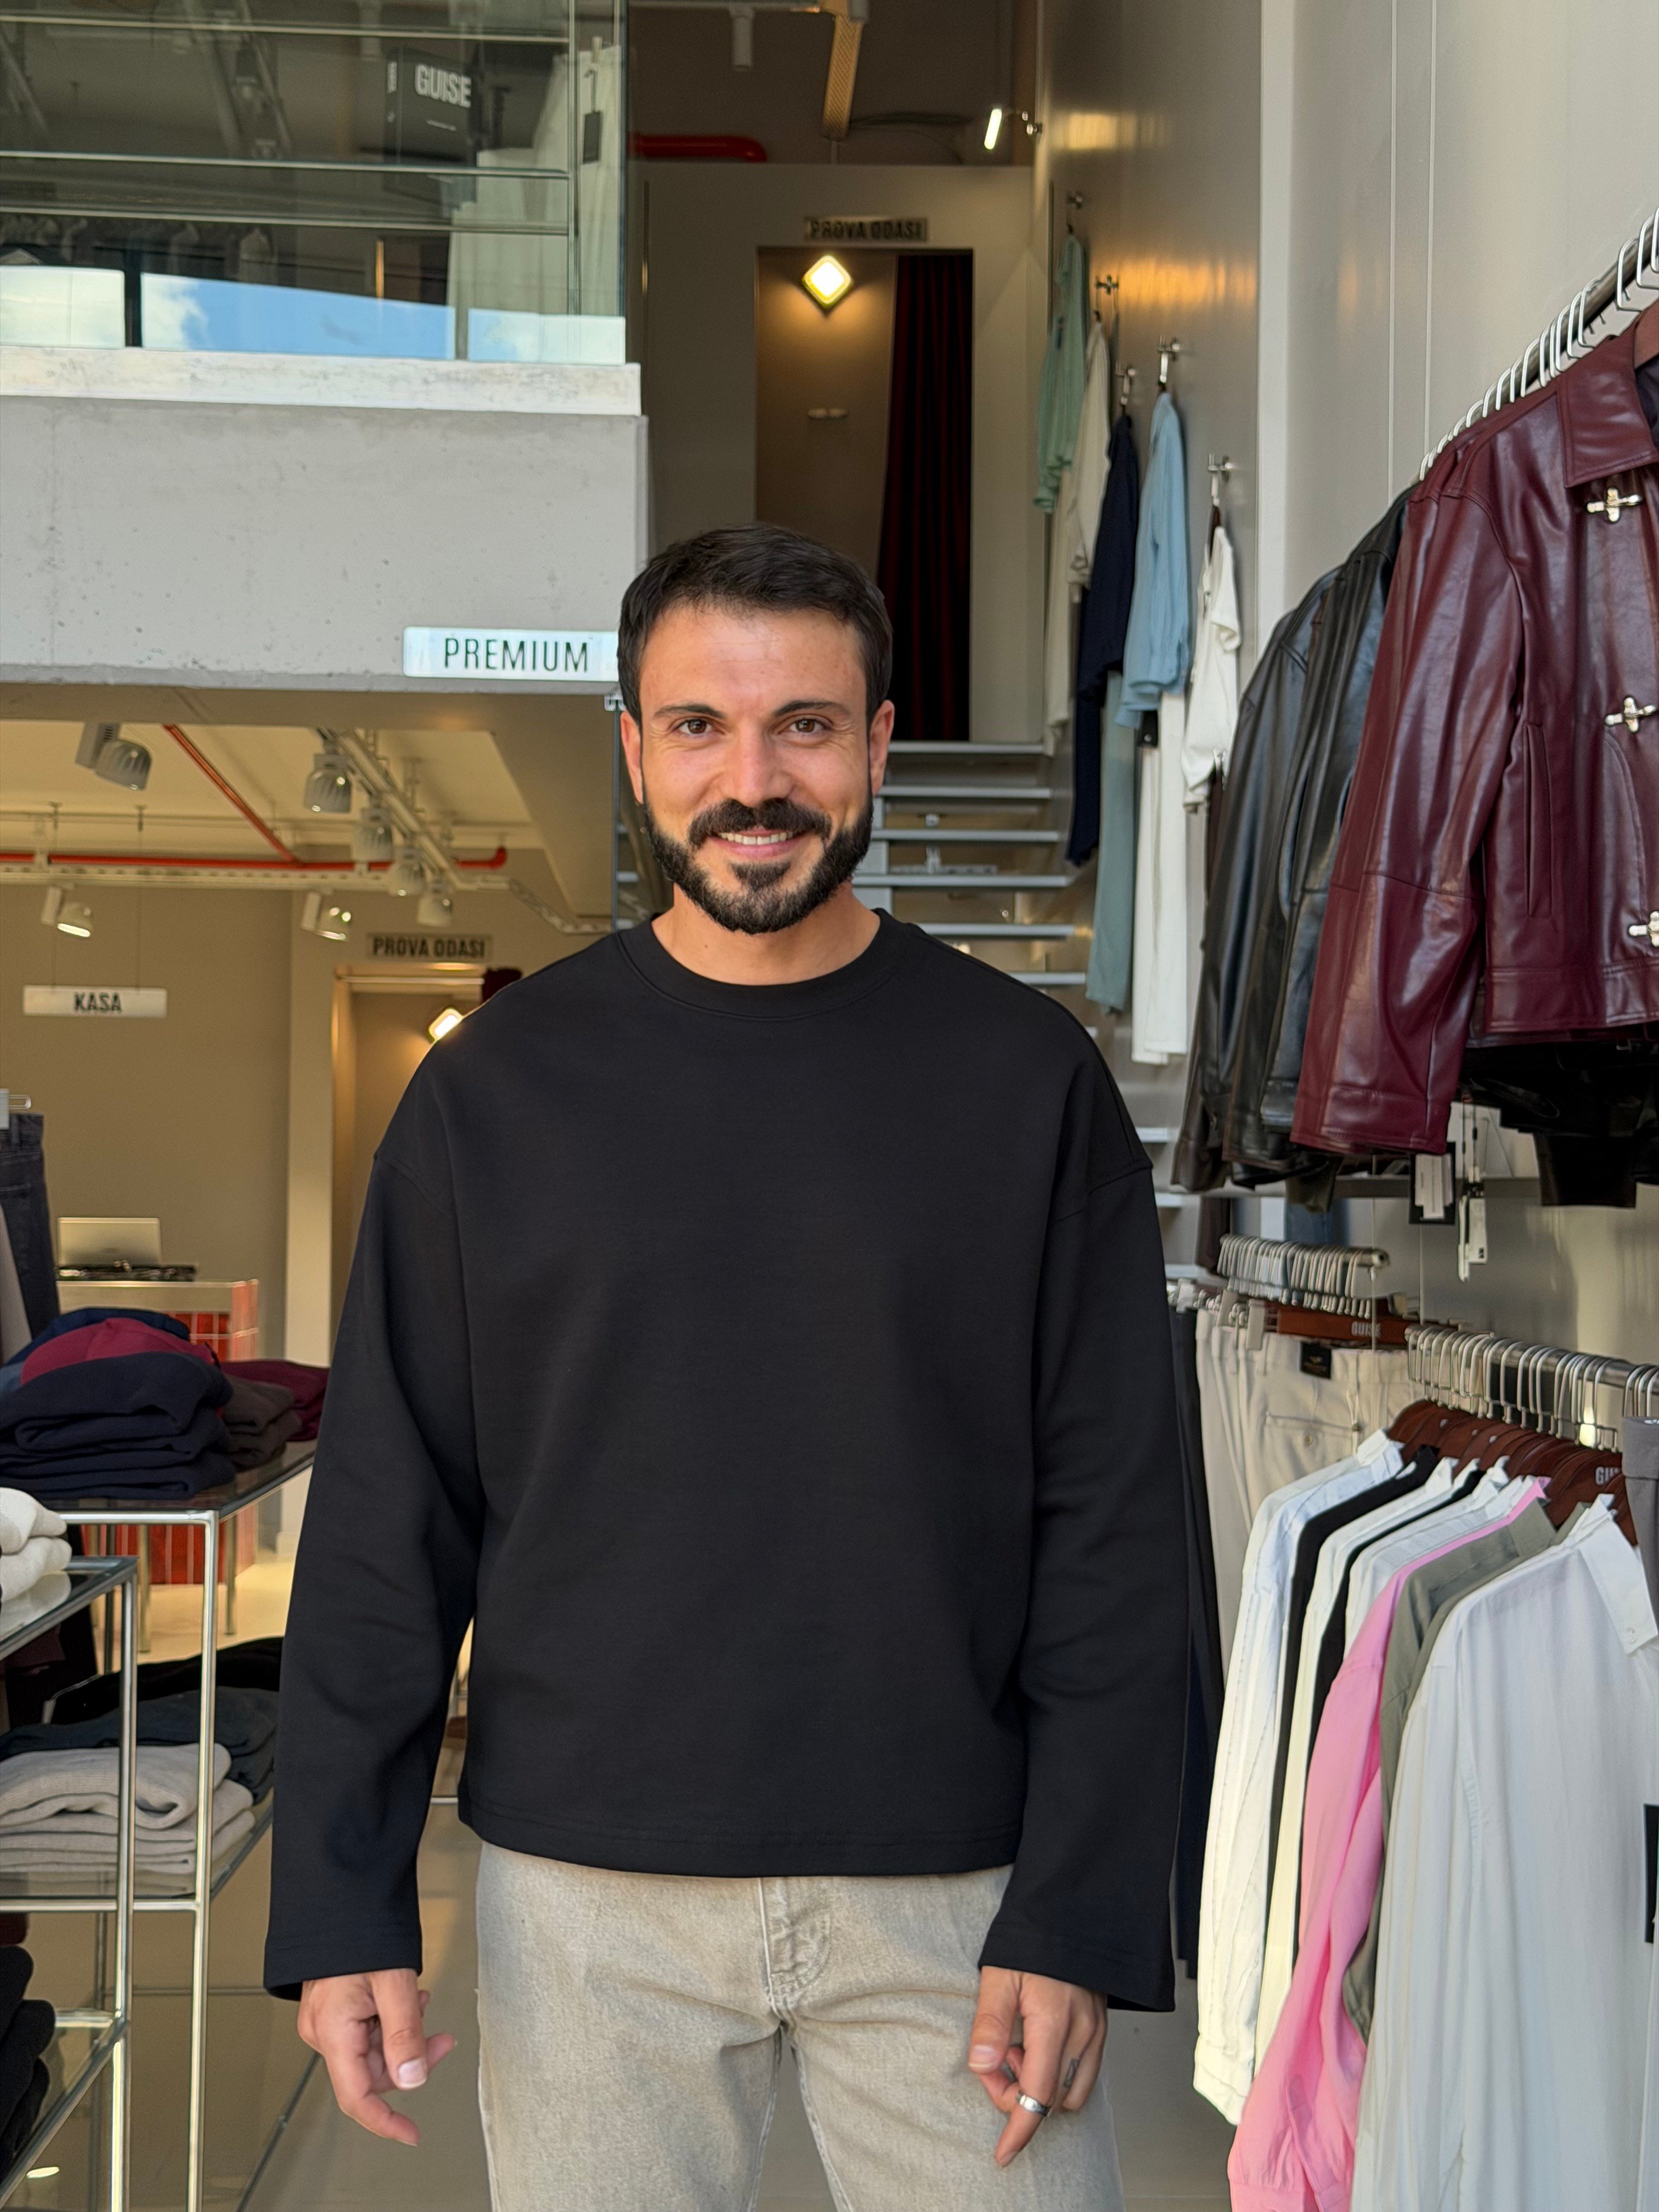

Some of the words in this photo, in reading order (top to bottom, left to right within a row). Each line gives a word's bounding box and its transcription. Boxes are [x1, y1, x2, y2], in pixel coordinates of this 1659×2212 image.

[415, 64, 471, 108] GUISE
[810, 221, 866, 239] PROVA
[871, 221, 923, 240] ODASI
[444, 637, 588, 673] PREMIUM
[373, 935, 429, 956] PROVA
[433, 938, 485, 958] ODASI
[74, 991, 122, 1013] KASA
